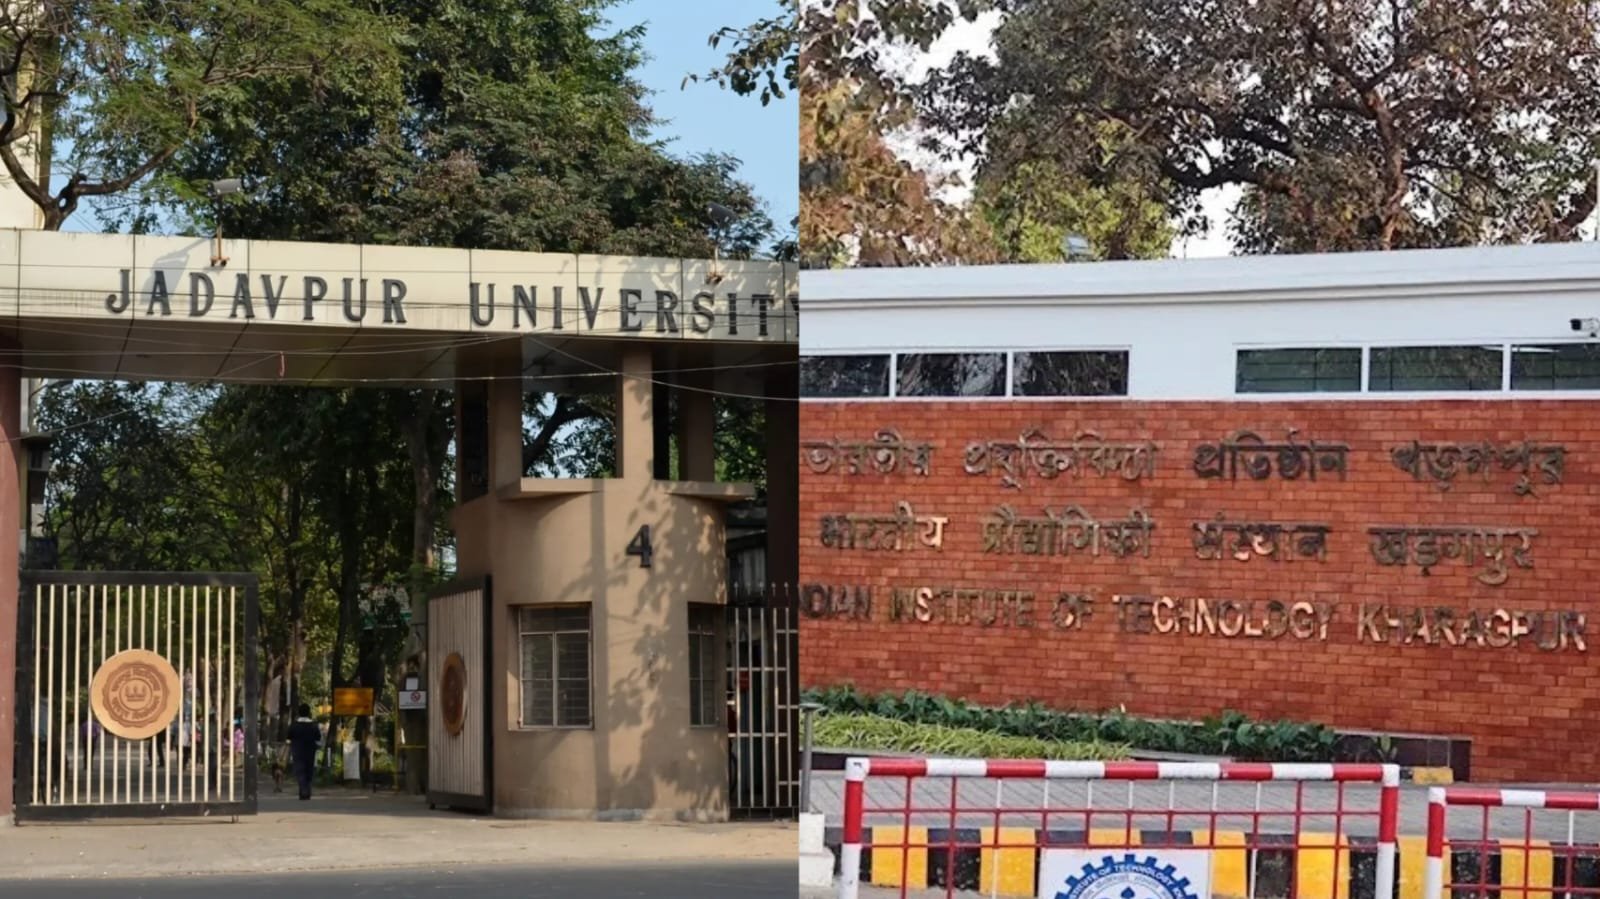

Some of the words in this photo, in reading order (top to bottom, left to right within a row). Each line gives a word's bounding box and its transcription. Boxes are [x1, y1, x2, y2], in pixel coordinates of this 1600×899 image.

[105, 269, 408, 324] JADAVPUR
[624, 524, 653, 569] 4
[819, 501, 949, 553] भारतीय
[1192, 512, 1332, 563] संस्थान
[889, 585, 1037, 629] INSTITUTE
[1051, 592, 1093, 631] OF
[1112, 594, 1336, 641] TECHNOLOGY
[1356, 601, 1588, 653] KHARAGPUR
